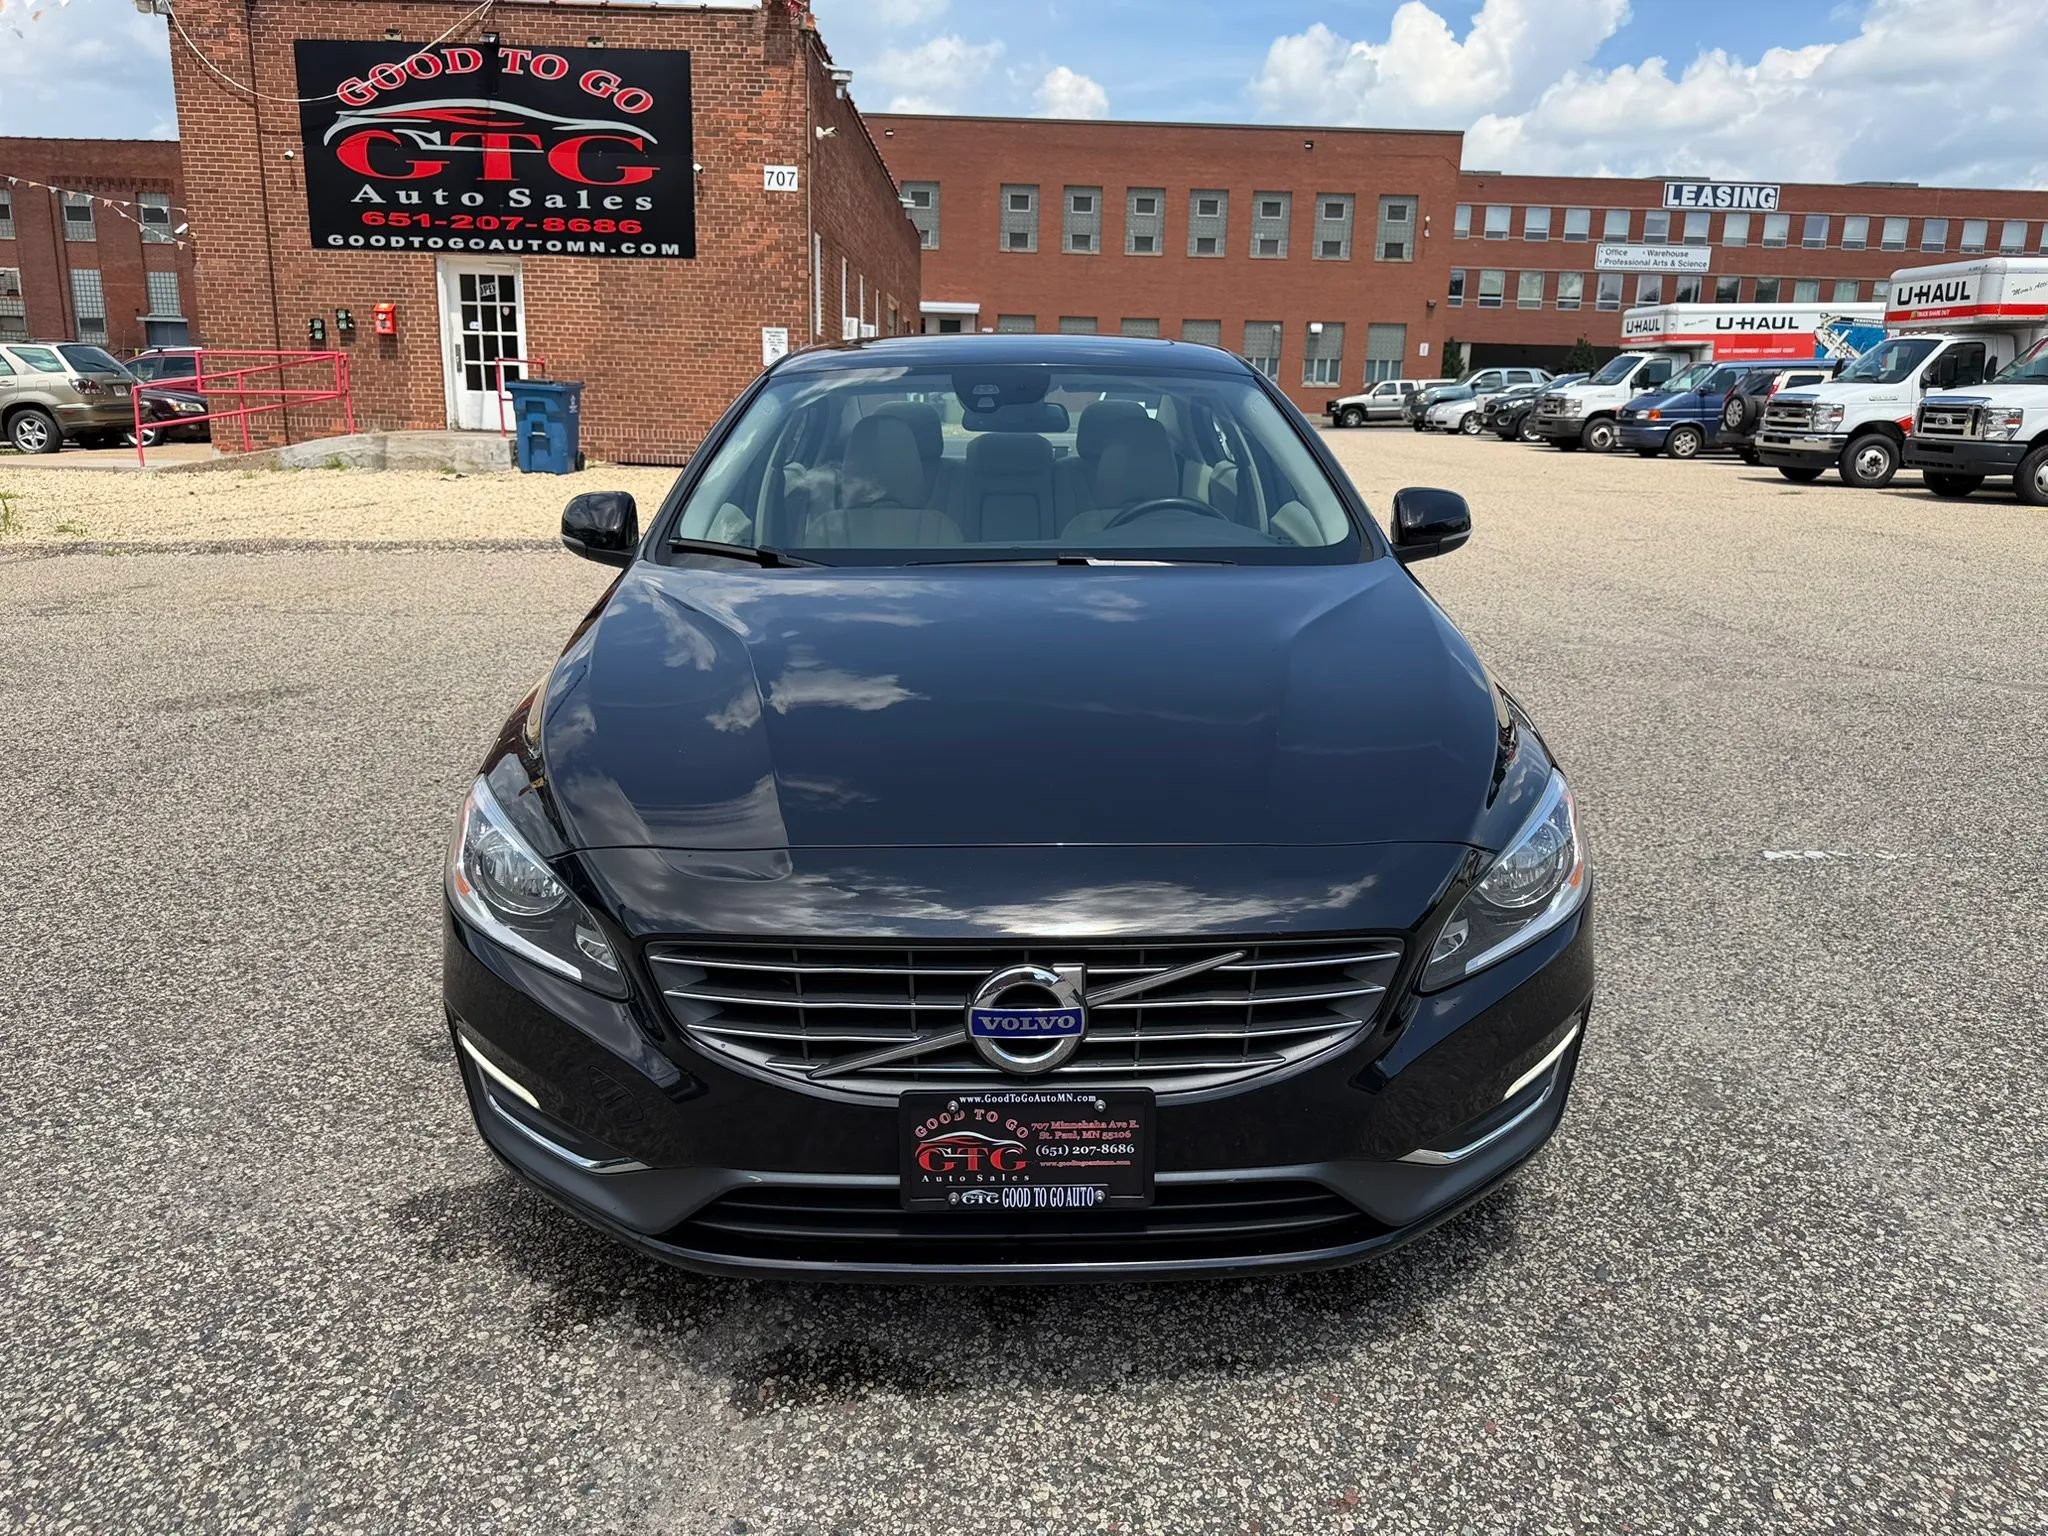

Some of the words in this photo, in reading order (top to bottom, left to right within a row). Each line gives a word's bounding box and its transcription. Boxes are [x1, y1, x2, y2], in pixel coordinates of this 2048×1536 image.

[335, 47, 483, 106] GOOD
[498, 48, 569, 81] TO
[578, 69, 655, 114] GO
[335, 129, 662, 186] GTG
[765, 171, 796, 187] 707
[350, 184, 484, 207] Auto
[509, 187, 654, 211] Sales
[1666, 185, 1776, 209] LEASING
[361, 211, 643, 234] 651-207-8686
[327, 234, 681, 256] GOODTOGOAUTOMN.COM
[1605, 248, 1628, 256] Office
[1647, 249, 1689, 258] Warehouse
[1604, 258, 1651, 267] Professional
[1652, 259, 1668, 267] Arts
[1678, 260, 1708, 268] Science
[1897, 280, 1971, 306] U-HAUL
[1626, 318, 1660, 333] U-HAUL
[1716, 317, 1799, 330] U-HAUL
[978, 1015, 1076, 1031] VOLVO
[959, 1093, 1097, 1103] www.GoodToGoAutoMN.com
[974, 1109, 999, 1123] TO
[1005, 1118, 1029, 1139] GO
[1031, 1123, 1049, 1131] 707
[1108, 1120, 1128, 1129] Ave
[1129, 1119, 1140, 1129] E.
[1039, 1131, 1053, 1140] St.
[1055, 1130, 1080, 1141] Paul,
[1082, 1130, 1100, 1139] MN
[1101, 1130, 1132, 1140] 55106
[1035, 1144, 1069, 1157] (651)
[1072, 1143, 1135, 1156] 207-8686
[916, 1146, 1029, 1172] GTG
[922, 1174, 966, 1183] Auto
[976, 1173, 1030, 1182] Sales
[1002, 1187, 1031, 1208] GOOD
[1033, 1187, 1047, 1208] TO
[1050, 1186, 1064, 1208] GO
[1065, 1186, 1095, 1207] AUTO
